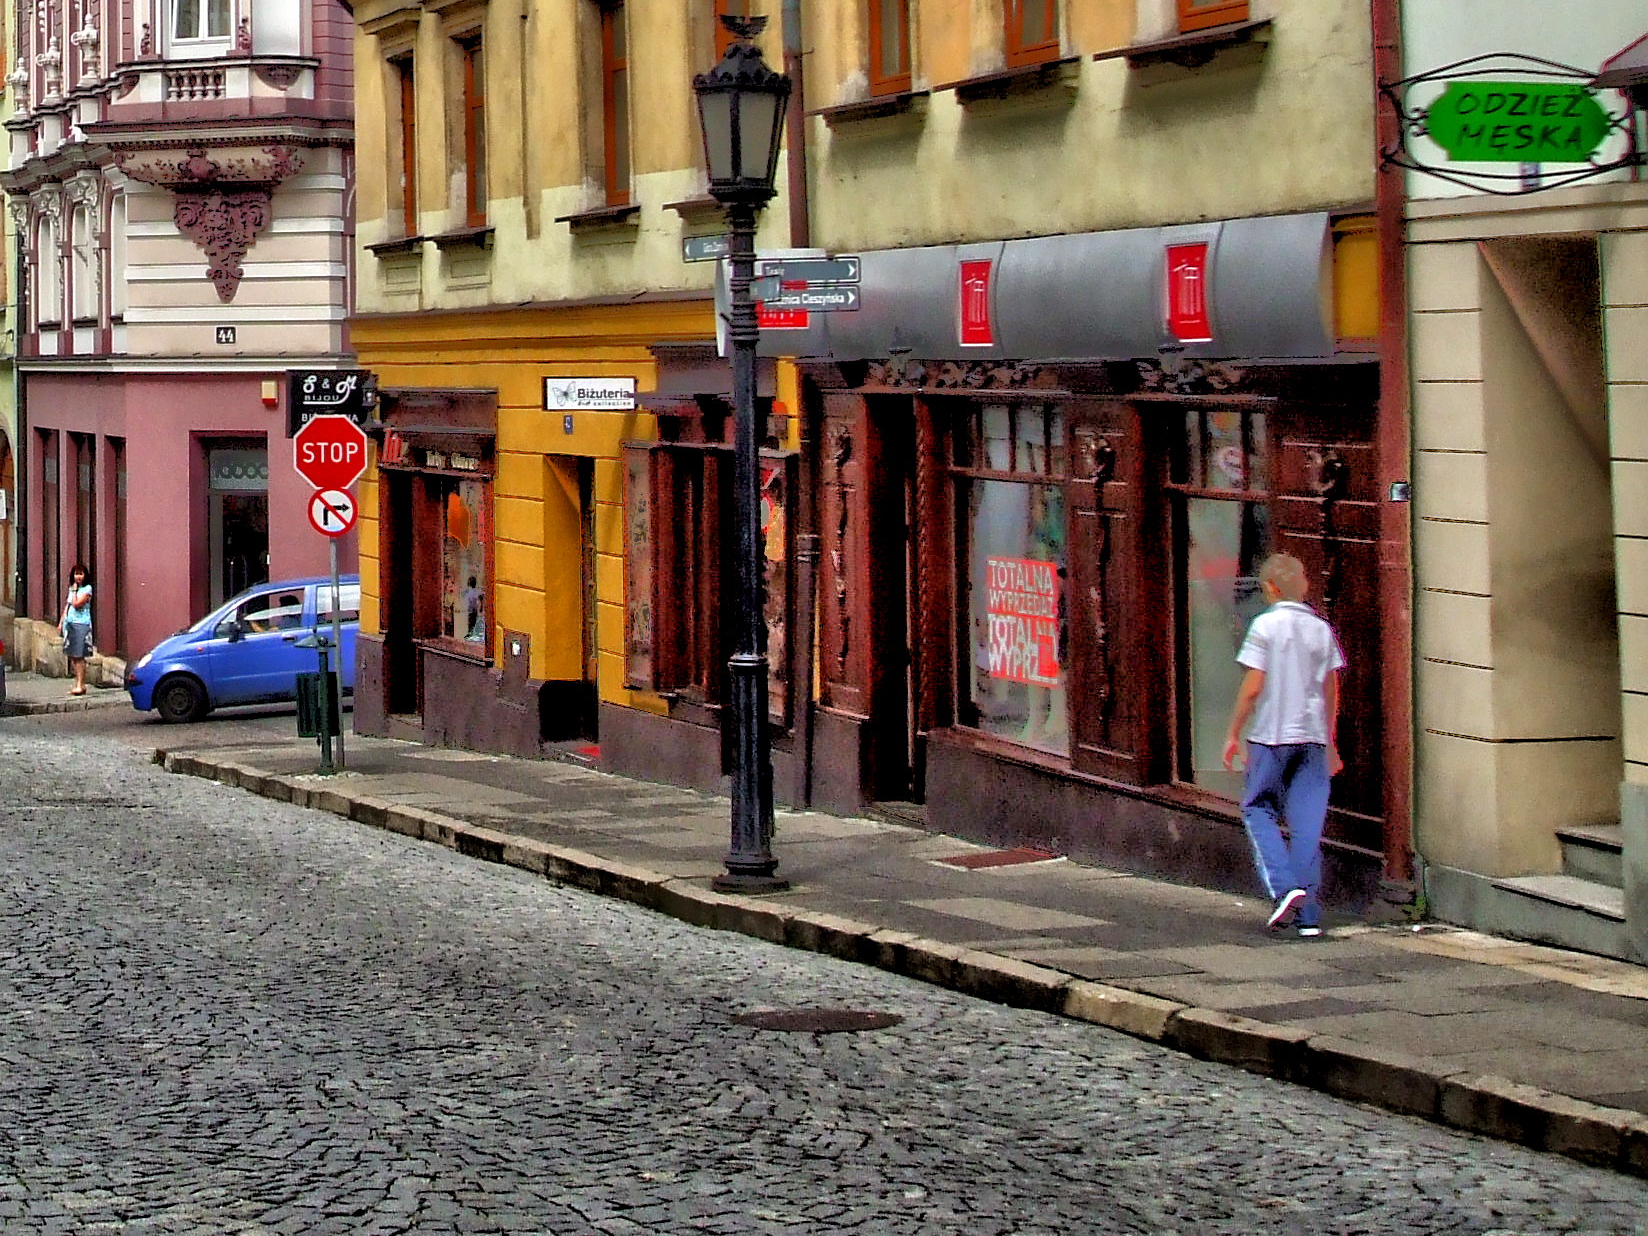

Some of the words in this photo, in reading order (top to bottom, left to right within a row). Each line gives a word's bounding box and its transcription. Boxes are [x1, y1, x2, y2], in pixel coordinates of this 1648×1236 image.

[1455, 87, 1583, 118] ODZIEŻ
[1455, 123, 1583, 155] MĘSKA
[802, 292, 845, 306] Cieszyńska
[218, 329, 235, 343] 44
[321, 378, 331, 389] &
[577, 388, 631, 399] Biżuteria
[302, 441, 359, 463] STOP
[988, 560, 1054, 595] TOTALNA
